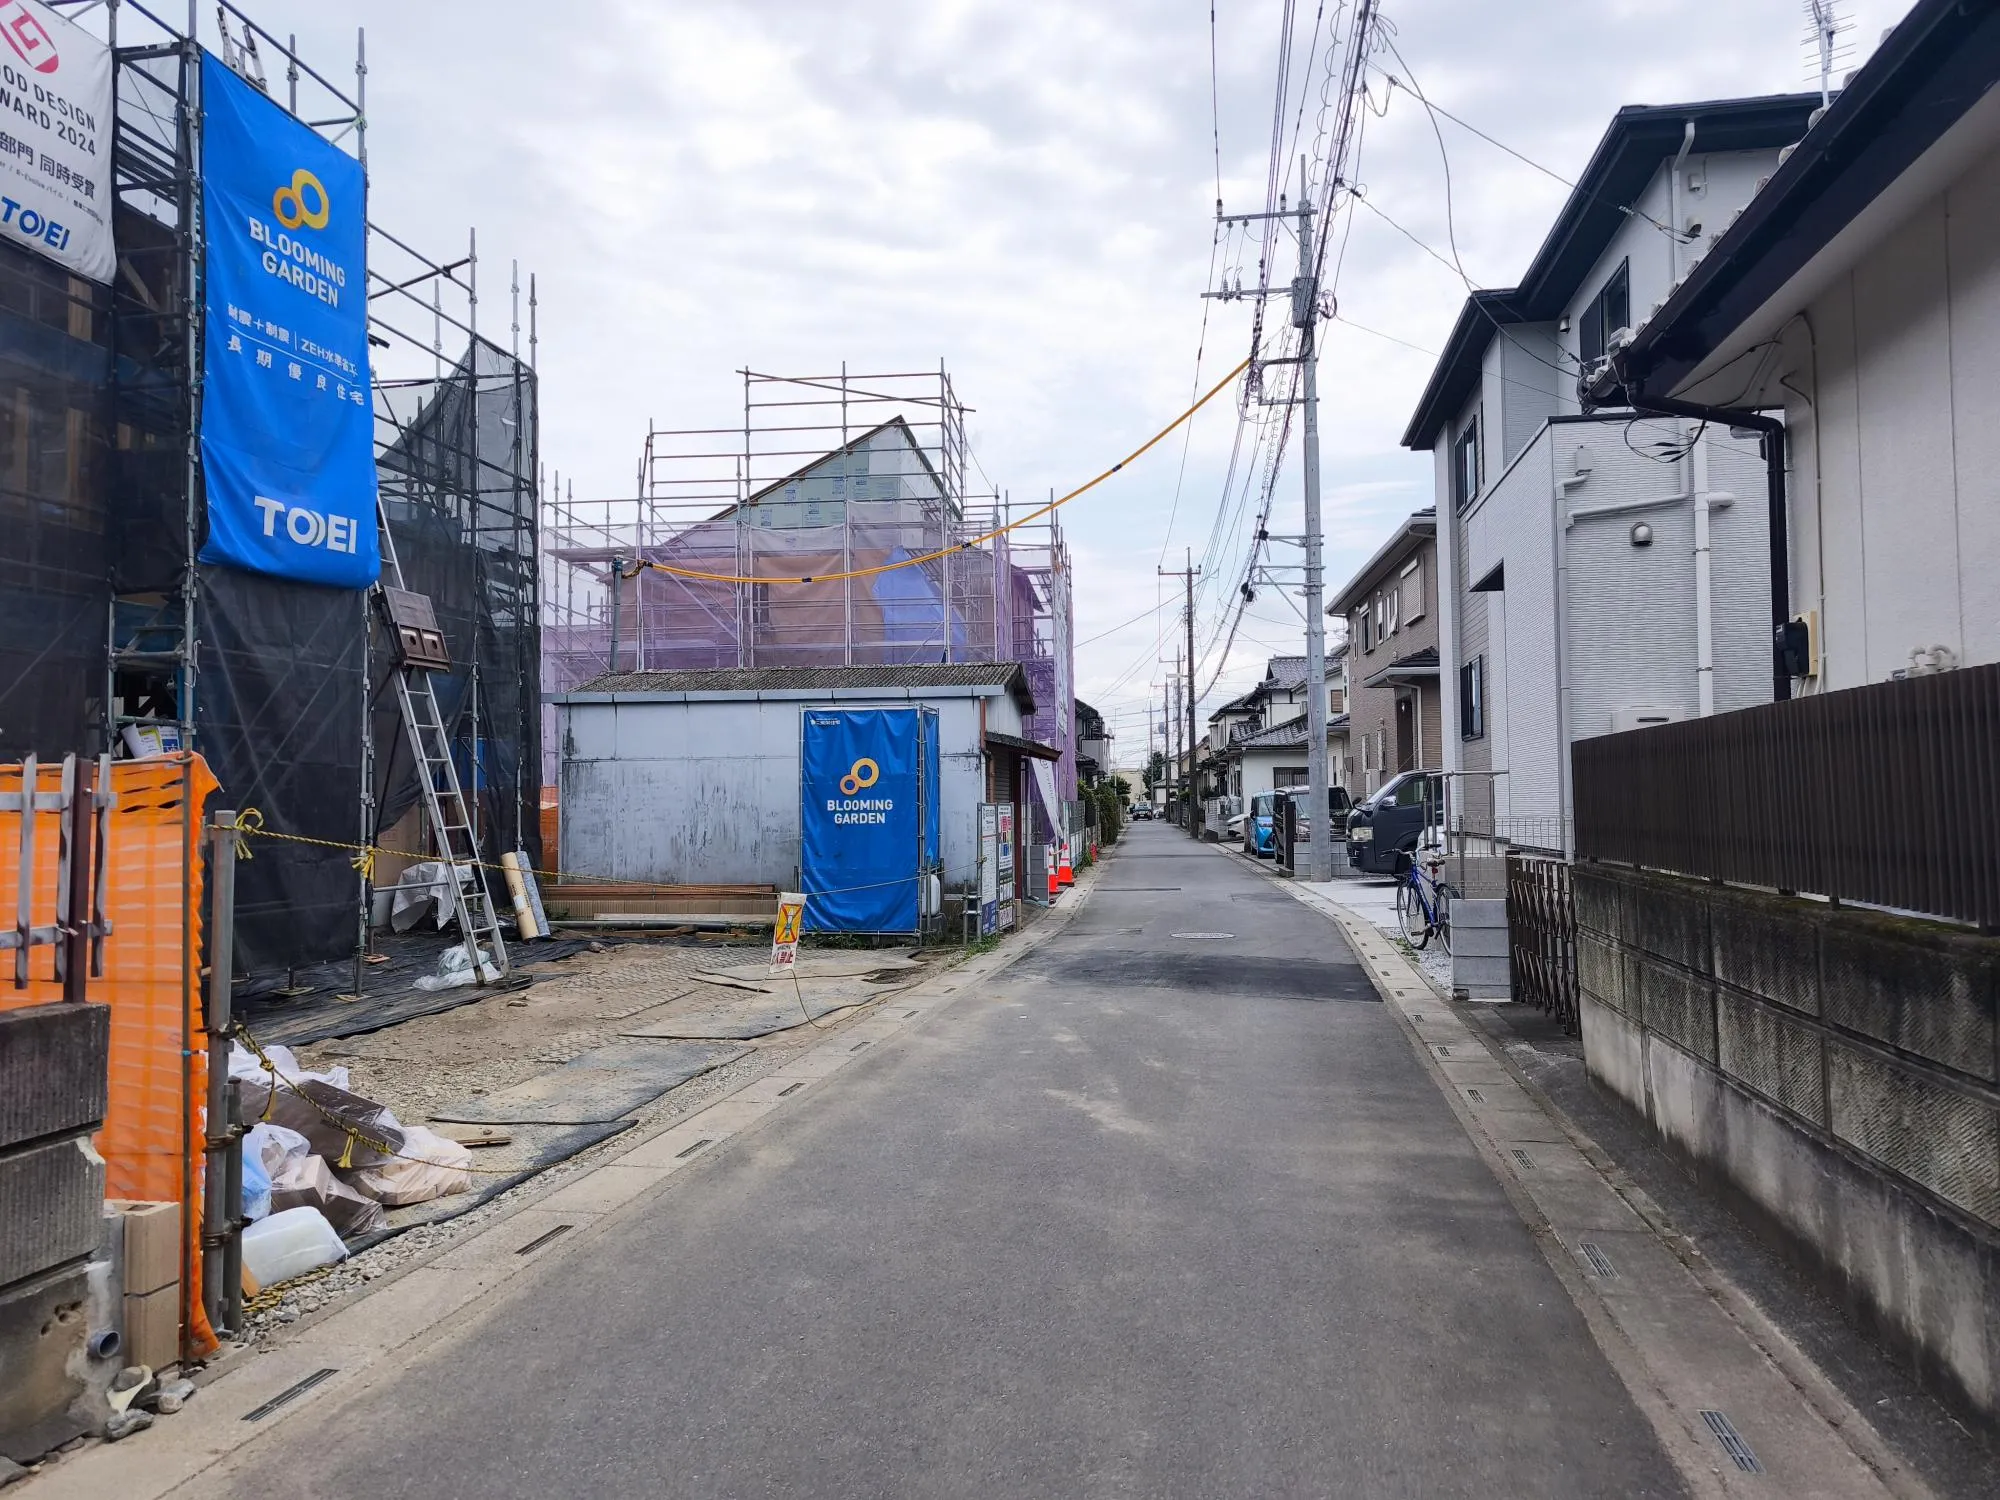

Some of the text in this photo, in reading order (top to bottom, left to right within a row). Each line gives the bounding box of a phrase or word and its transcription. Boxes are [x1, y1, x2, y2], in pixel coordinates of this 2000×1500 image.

[0, 64, 96, 133] OD DESIGN
[57, 120, 96, 156] 2024
[40, 153, 96, 202] 同時受賞
[1, 195, 71, 251] TOEI
[249, 216, 346, 288] BLOOMING
[262, 251, 338, 308] GARDEN
[254, 495, 358, 554] TOEI
[826, 799, 894, 811] BLOOMING
[833, 812, 886, 824] GARDEN
